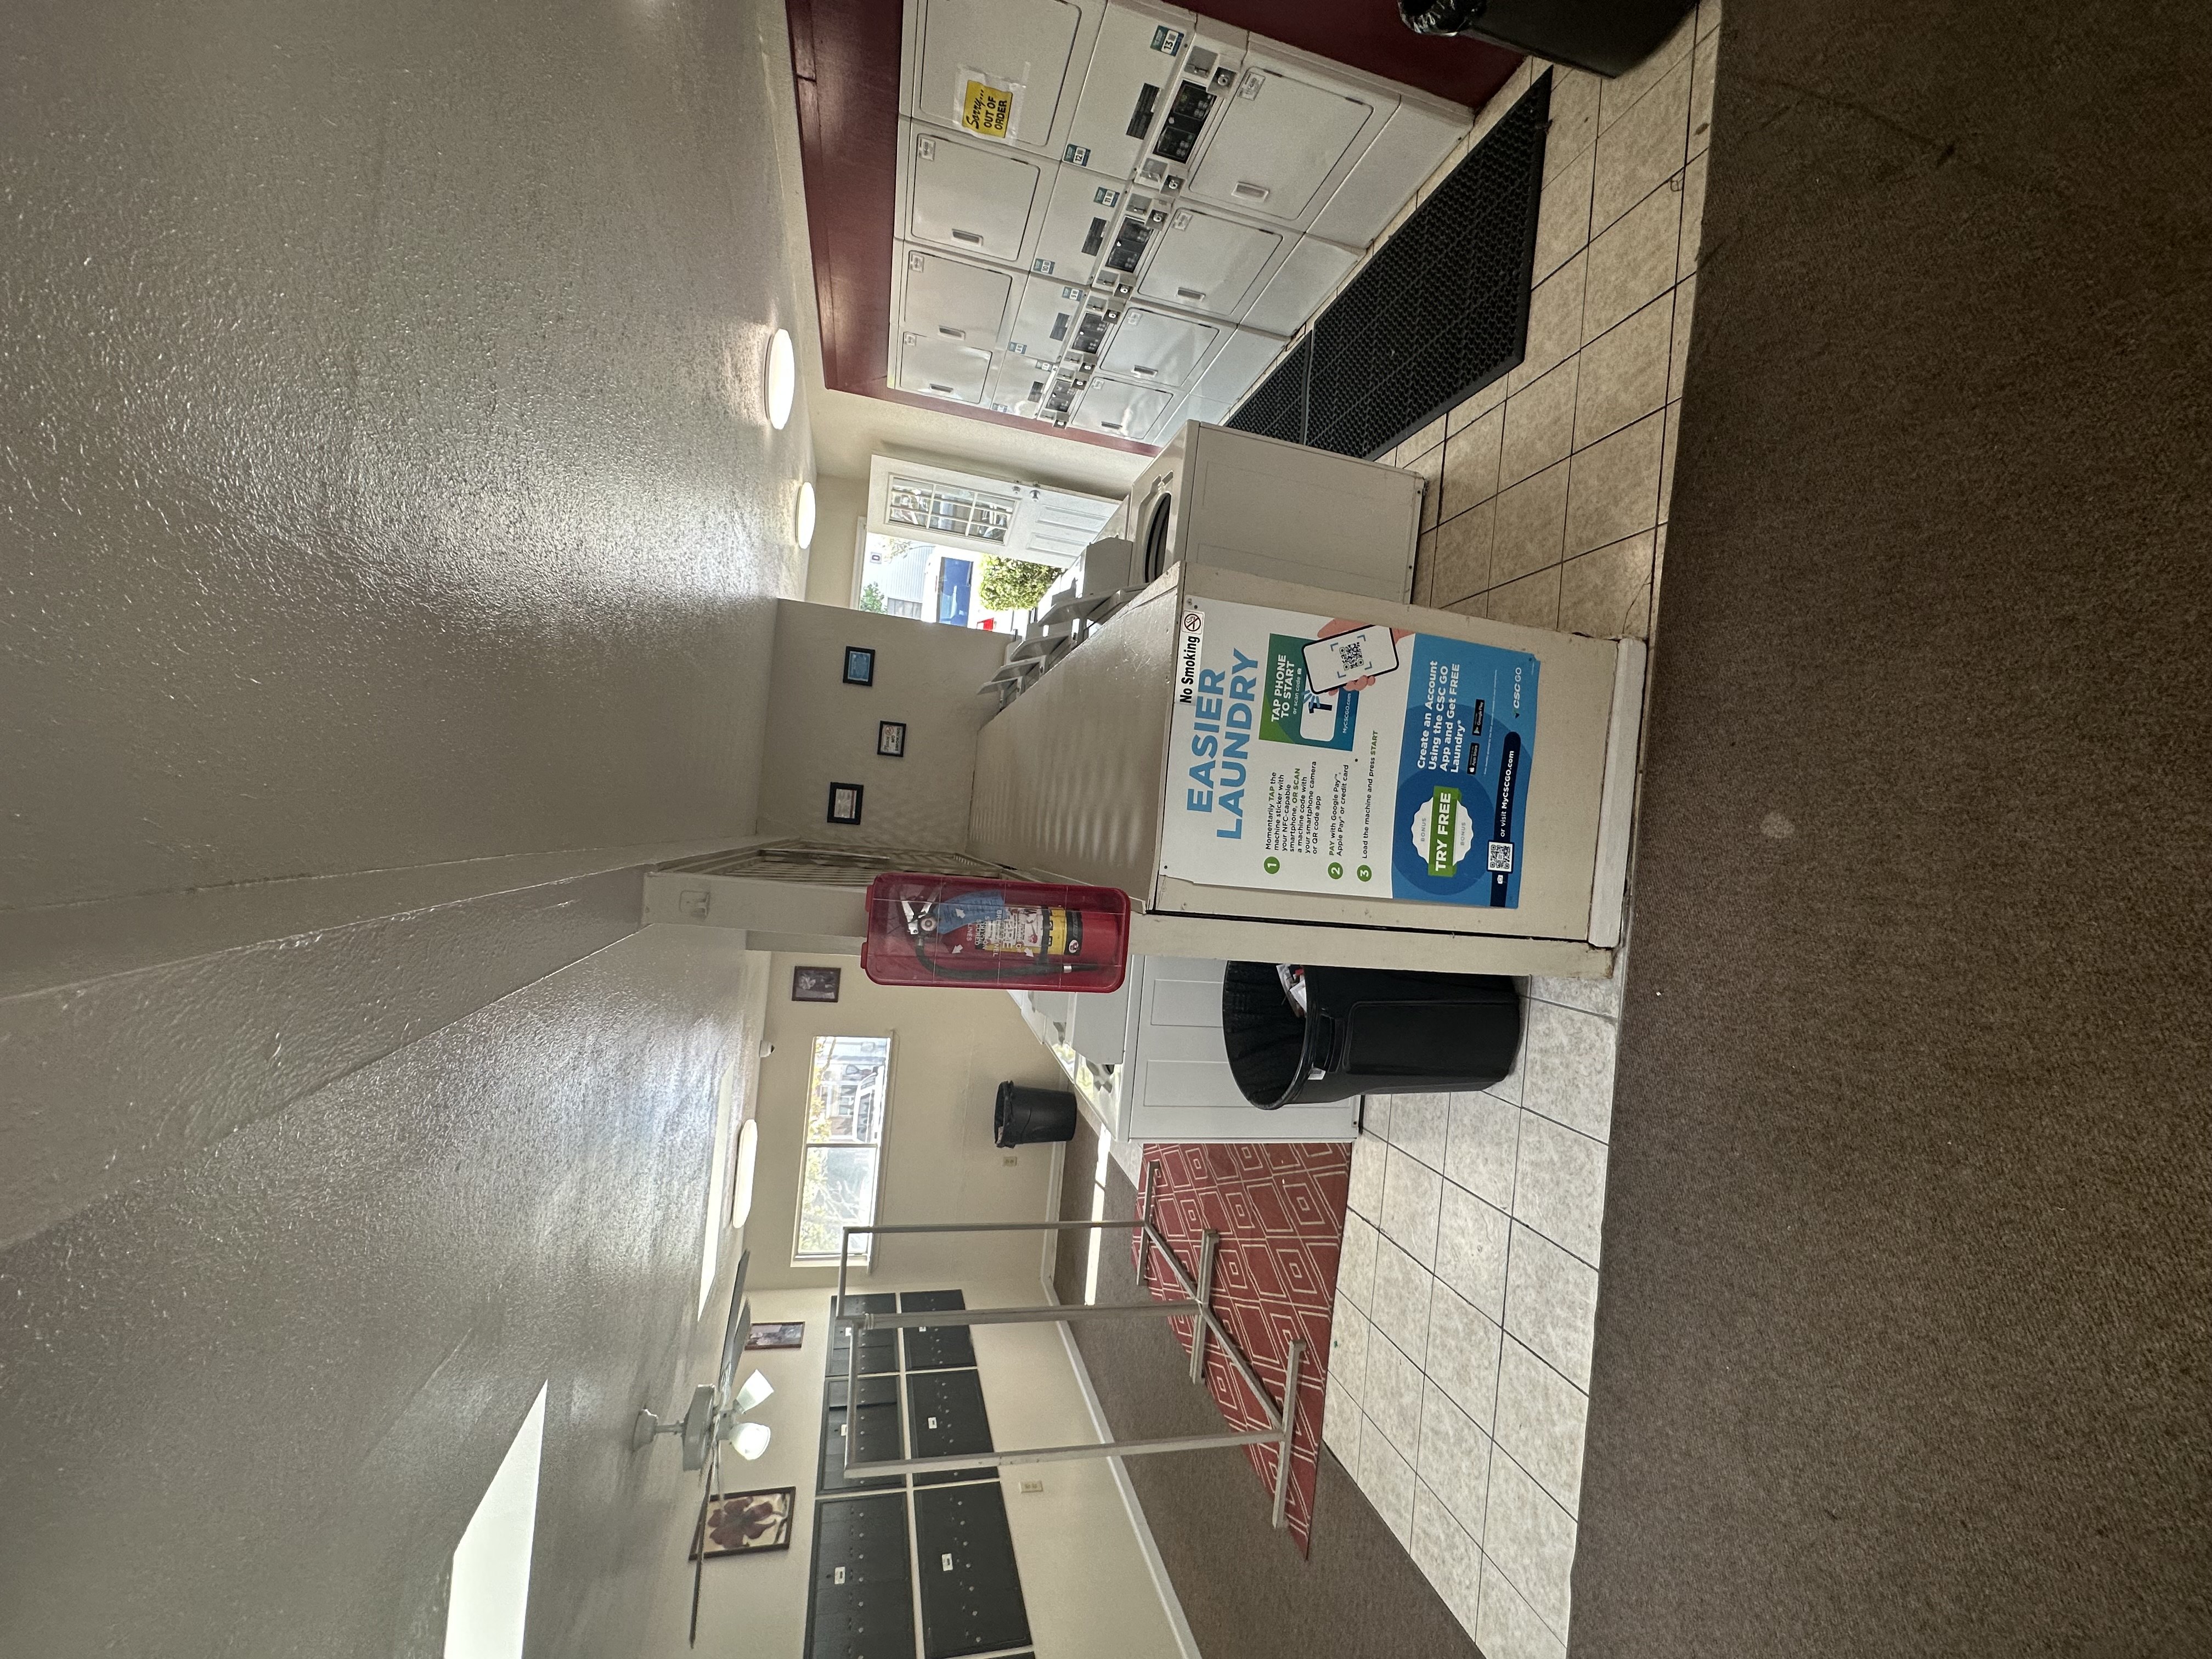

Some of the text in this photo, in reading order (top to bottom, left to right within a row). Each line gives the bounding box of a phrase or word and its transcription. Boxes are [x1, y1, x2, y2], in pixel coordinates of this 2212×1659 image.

[1164, 41, 1173, 50] 13
[966, 89, 985, 129] Sorry...
[984, 96, 996, 128] OUT OF
[995, 100, 1007, 129] ORDER
[1180, 636, 1200, 703] No Smoking
[1271, 654, 1286, 721] TAP PHONE
[1280, 661, 1295, 718] TO START
[1515, 667, 1521, 682] GO
[1342, 693, 1351, 733] MyCSCGO.com
[1417, 661, 1438, 769] Create an Account
[1428, 665, 1448, 770] Using the CSC GO
[1440, 664, 1460, 771] App and Get FREE
[1186, 668, 1225, 812] EASIER
[1217, 648, 1258, 839] LAUNDRY
[1292, 792, 1298, 803] OR
[1502, 751, 1514, 809] MyCSCGO.com
[1266, 804, 1274, 850] Momentarily
[1283, 785, 1291, 832] NFC-capable
[1290, 806, 1298, 851] smartphone,
[1306, 791, 1314, 834] smartphone
[1331, 794, 1339, 820] Google
[1312, 832, 1318, 844] QR
[1435, 792, 1451, 871] TRY FREE
[1500, 828, 1505, 837] or
